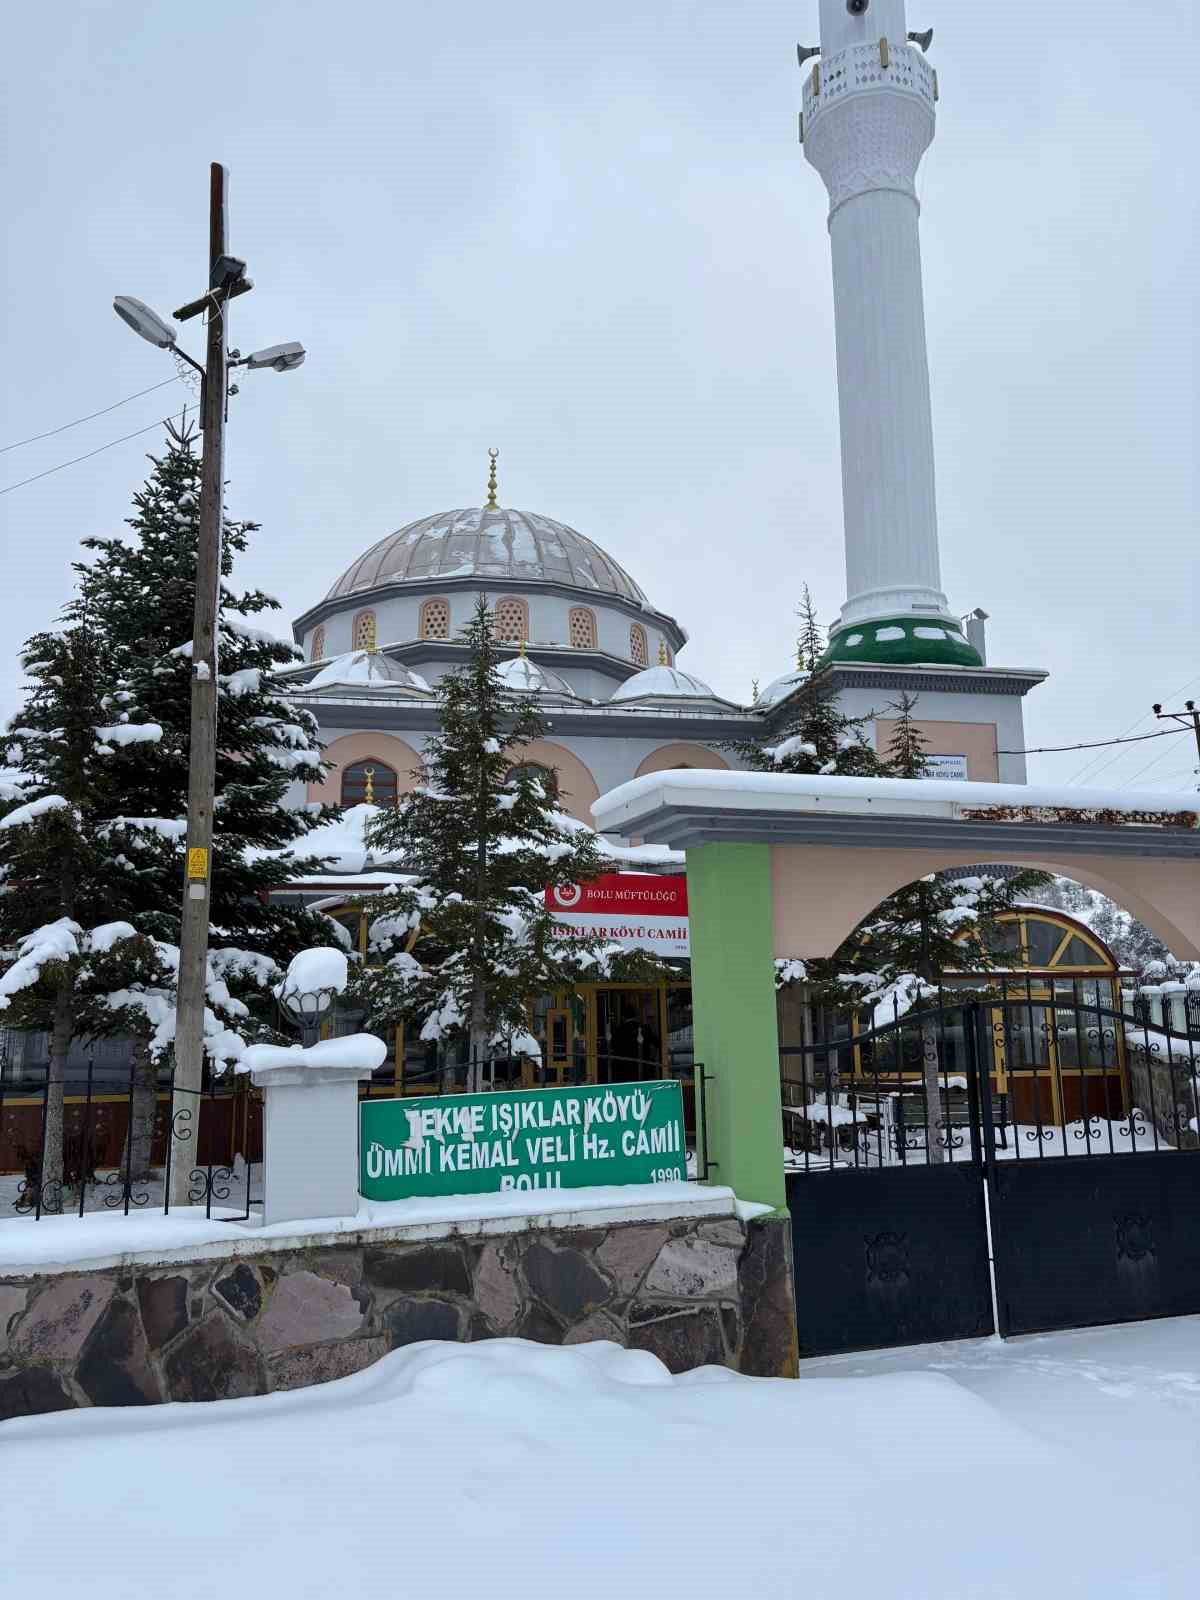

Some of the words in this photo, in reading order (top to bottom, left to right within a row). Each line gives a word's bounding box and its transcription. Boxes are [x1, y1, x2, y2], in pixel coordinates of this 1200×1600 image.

[587, 889, 613, 900] BOLU
[615, 889, 677, 903] MÜFTÜLÜĞÜ
[609, 925, 645, 938] KÖYÜ
[647, 927, 687, 940] CAMİİ
[491, 1098, 581, 1138] IŞIKLAR
[587, 1089, 647, 1124] KÖYÜ
[439, 1140, 520, 1172] KEMAL
[526, 1128, 576, 1165] VELİ
[583, 1132, 616, 1160] Hz.
[621, 1119, 681, 1157] CAMİİ
[650, 1167, 682, 1184] 1990
